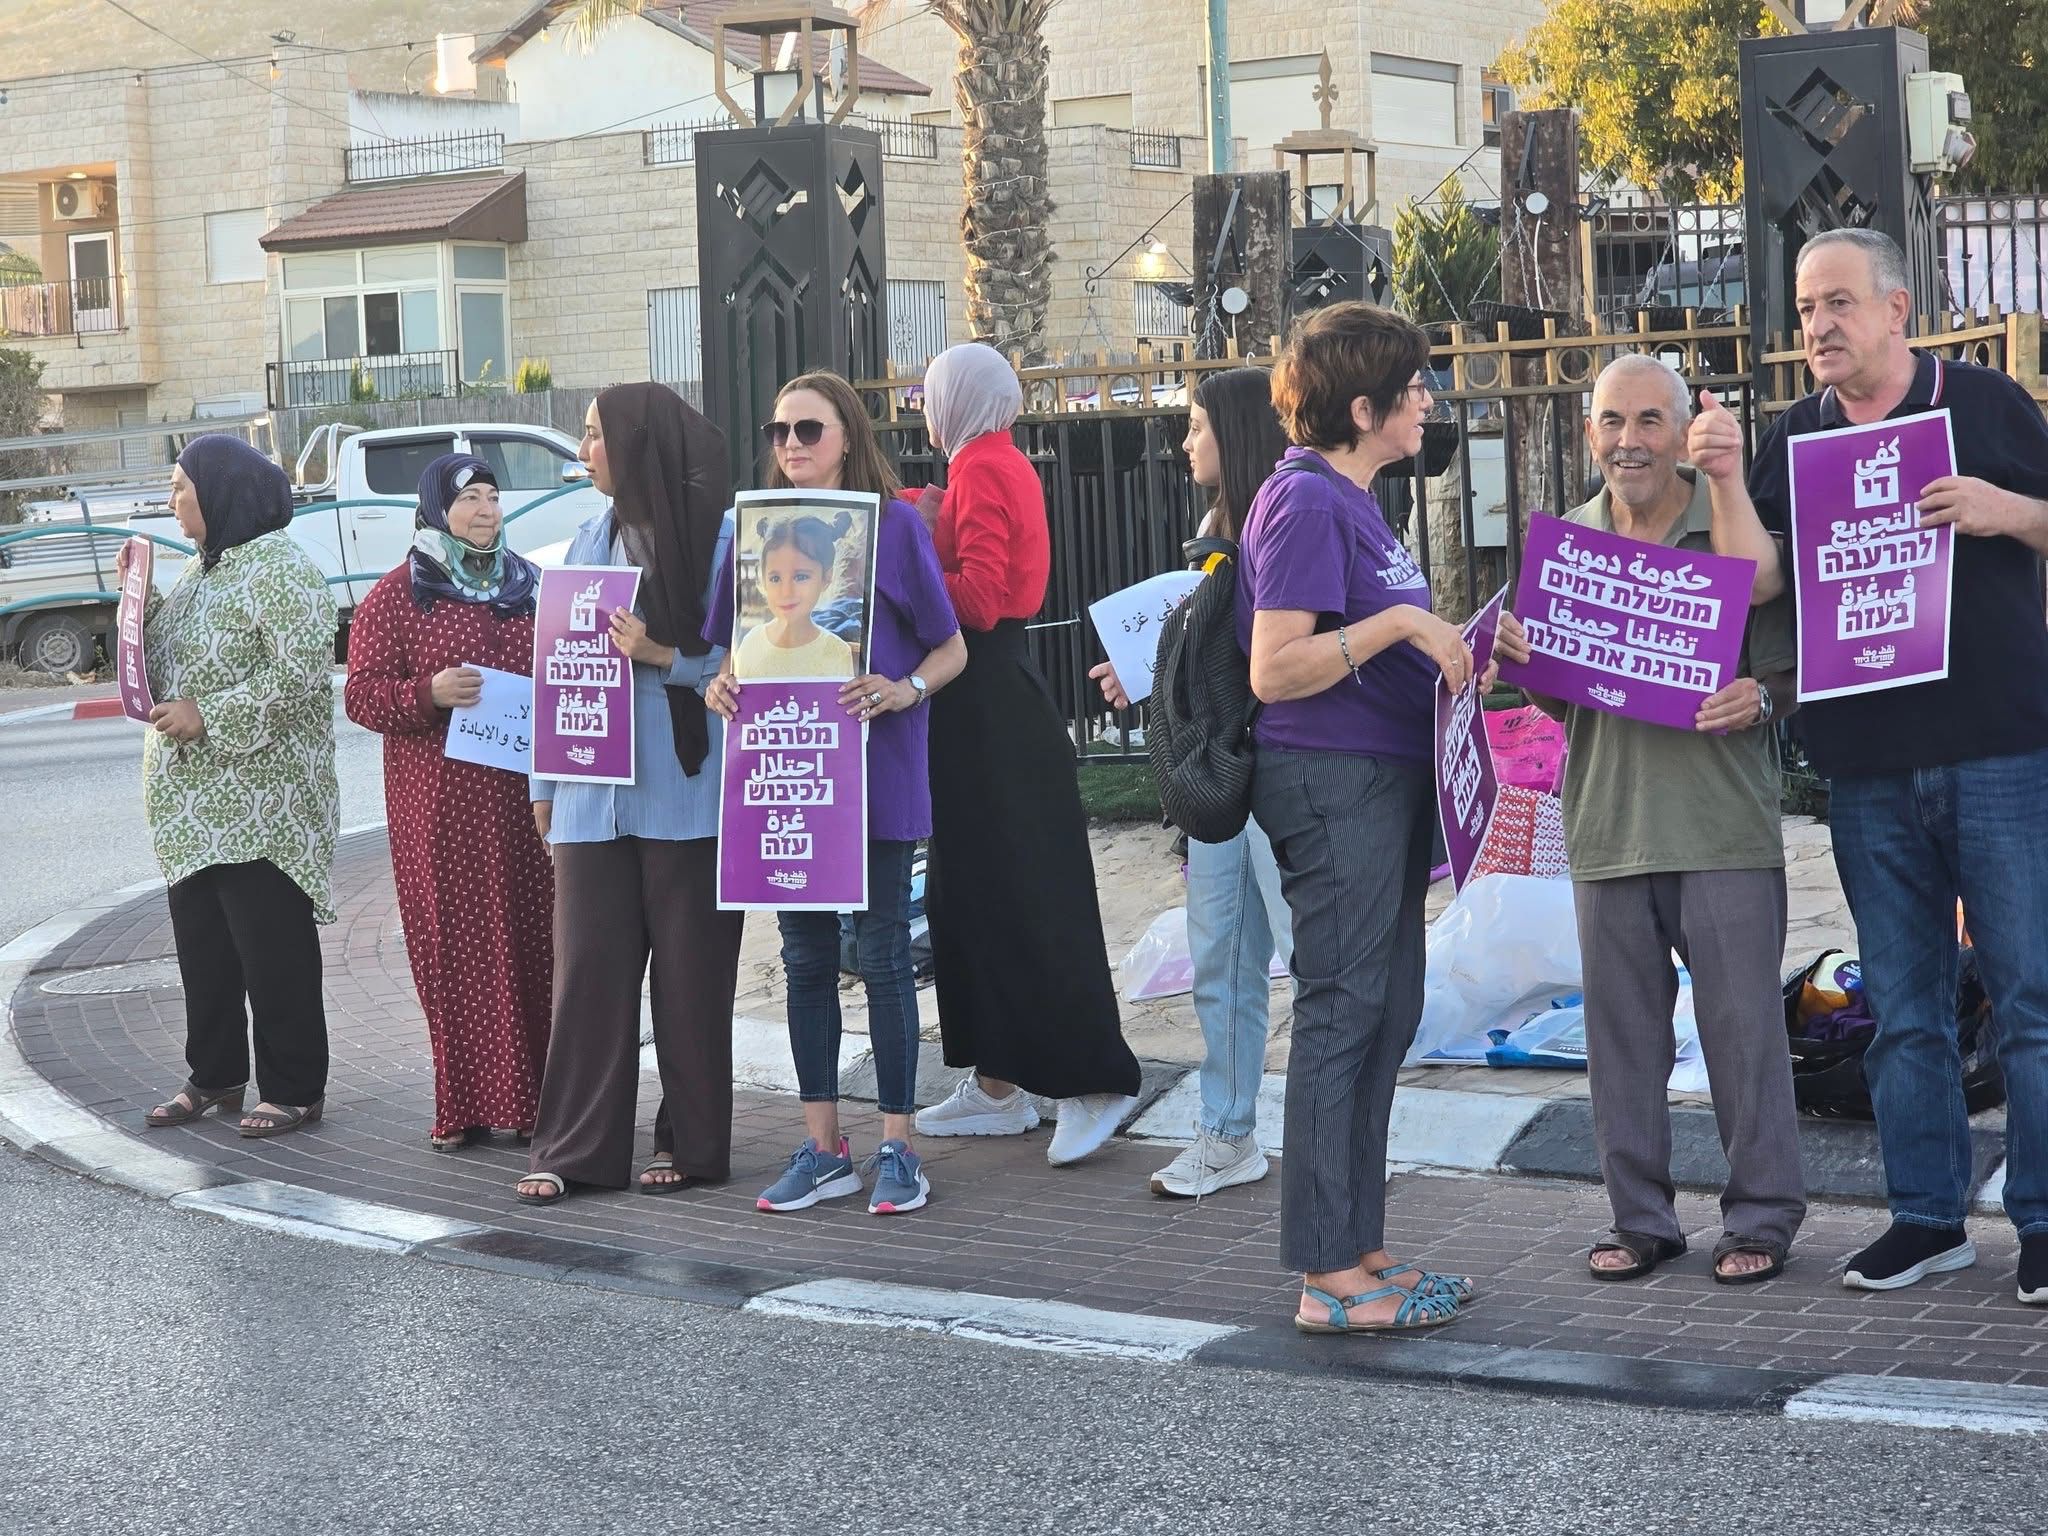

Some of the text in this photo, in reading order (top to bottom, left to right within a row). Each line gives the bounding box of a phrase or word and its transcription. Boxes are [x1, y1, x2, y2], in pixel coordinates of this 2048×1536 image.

[1862, 476, 1891, 498] די
[1830, 502, 1920, 549] التجويع
[1557, 533, 1712, 593] حكومة دموية
[1824, 537, 1933, 574] להרעבה
[1547, 568, 1712, 624] ממשלת דמים
[1841, 569, 1915, 613] في غزة
[575, 608, 591, 626] די
[1121, 611, 1149, 632] غزة
[1845, 606, 1910, 632] בעזה
[554, 633, 609, 660] التجويع
[1627, 618, 1698, 656] تقتلنا
[1527, 623, 1712, 687] הורגת את כולנו
[550, 661, 618, 682] להרעבה
[559, 687, 607, 717] في غزة
[754, 695, 820, 727] نرفض
[459, 718, 509, 746] والإبادة
[562, 712, 604, 732] בעזה
[746, 726, 832, 745] מסרבים
[751, 752, 824, 783] احتلال
[749, 780, 828, 801] לכיבוש
[767, 808, 805, 837] غزة
[765, 837, 808, 856] עזה
